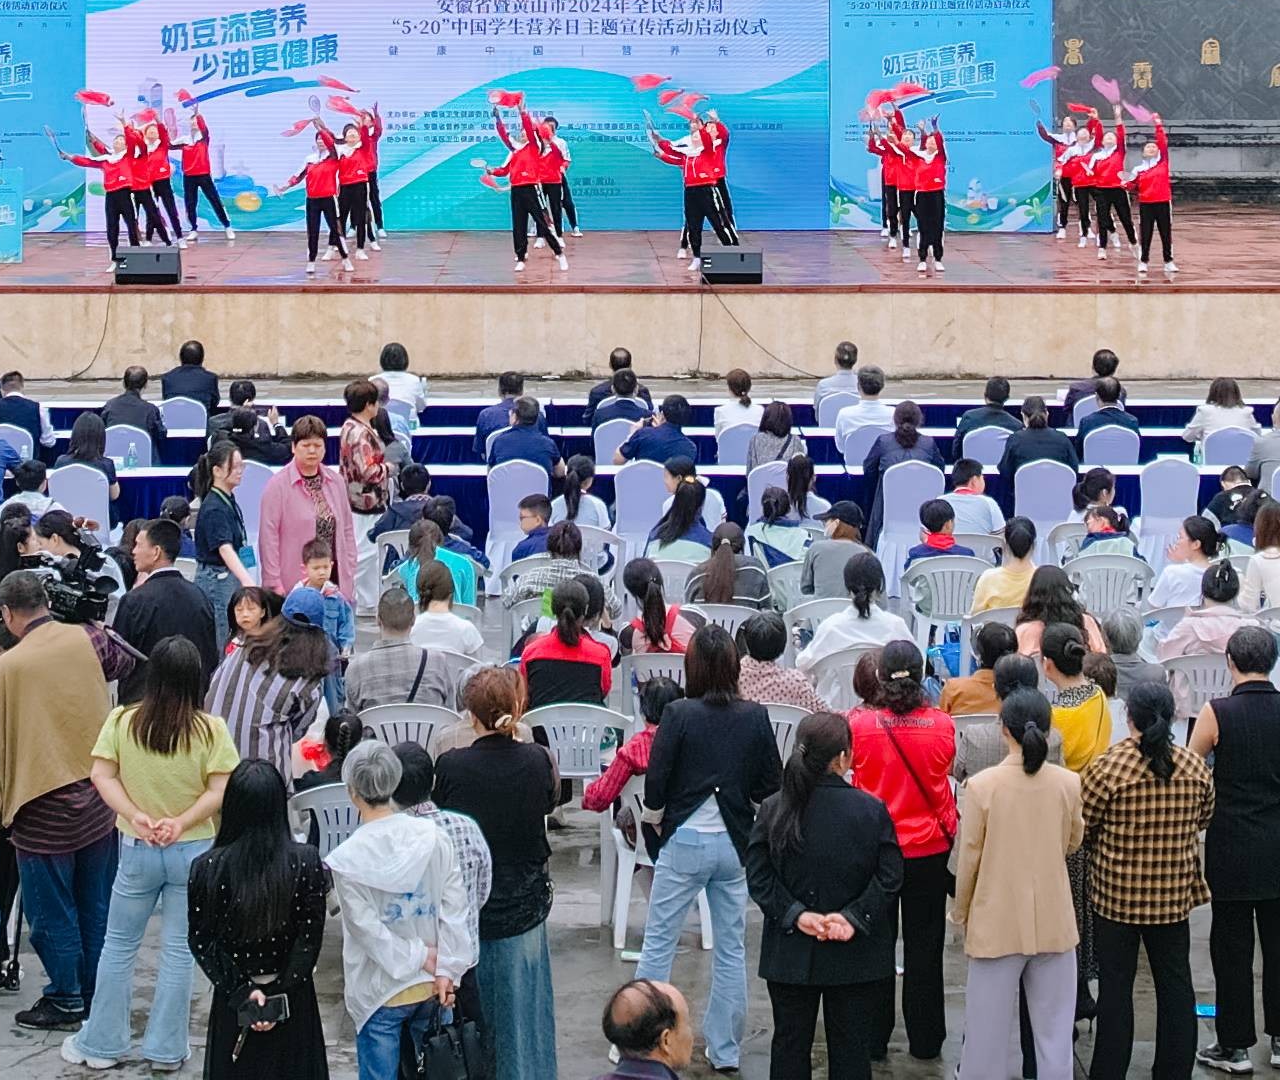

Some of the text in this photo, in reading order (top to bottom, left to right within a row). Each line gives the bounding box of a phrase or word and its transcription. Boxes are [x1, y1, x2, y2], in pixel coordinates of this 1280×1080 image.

[161, 3, 308, 56] 奶豆添营养
[192, 34, 339, 85] 少油更健康
[883, 42, 975, 75] 奶豆添营养
